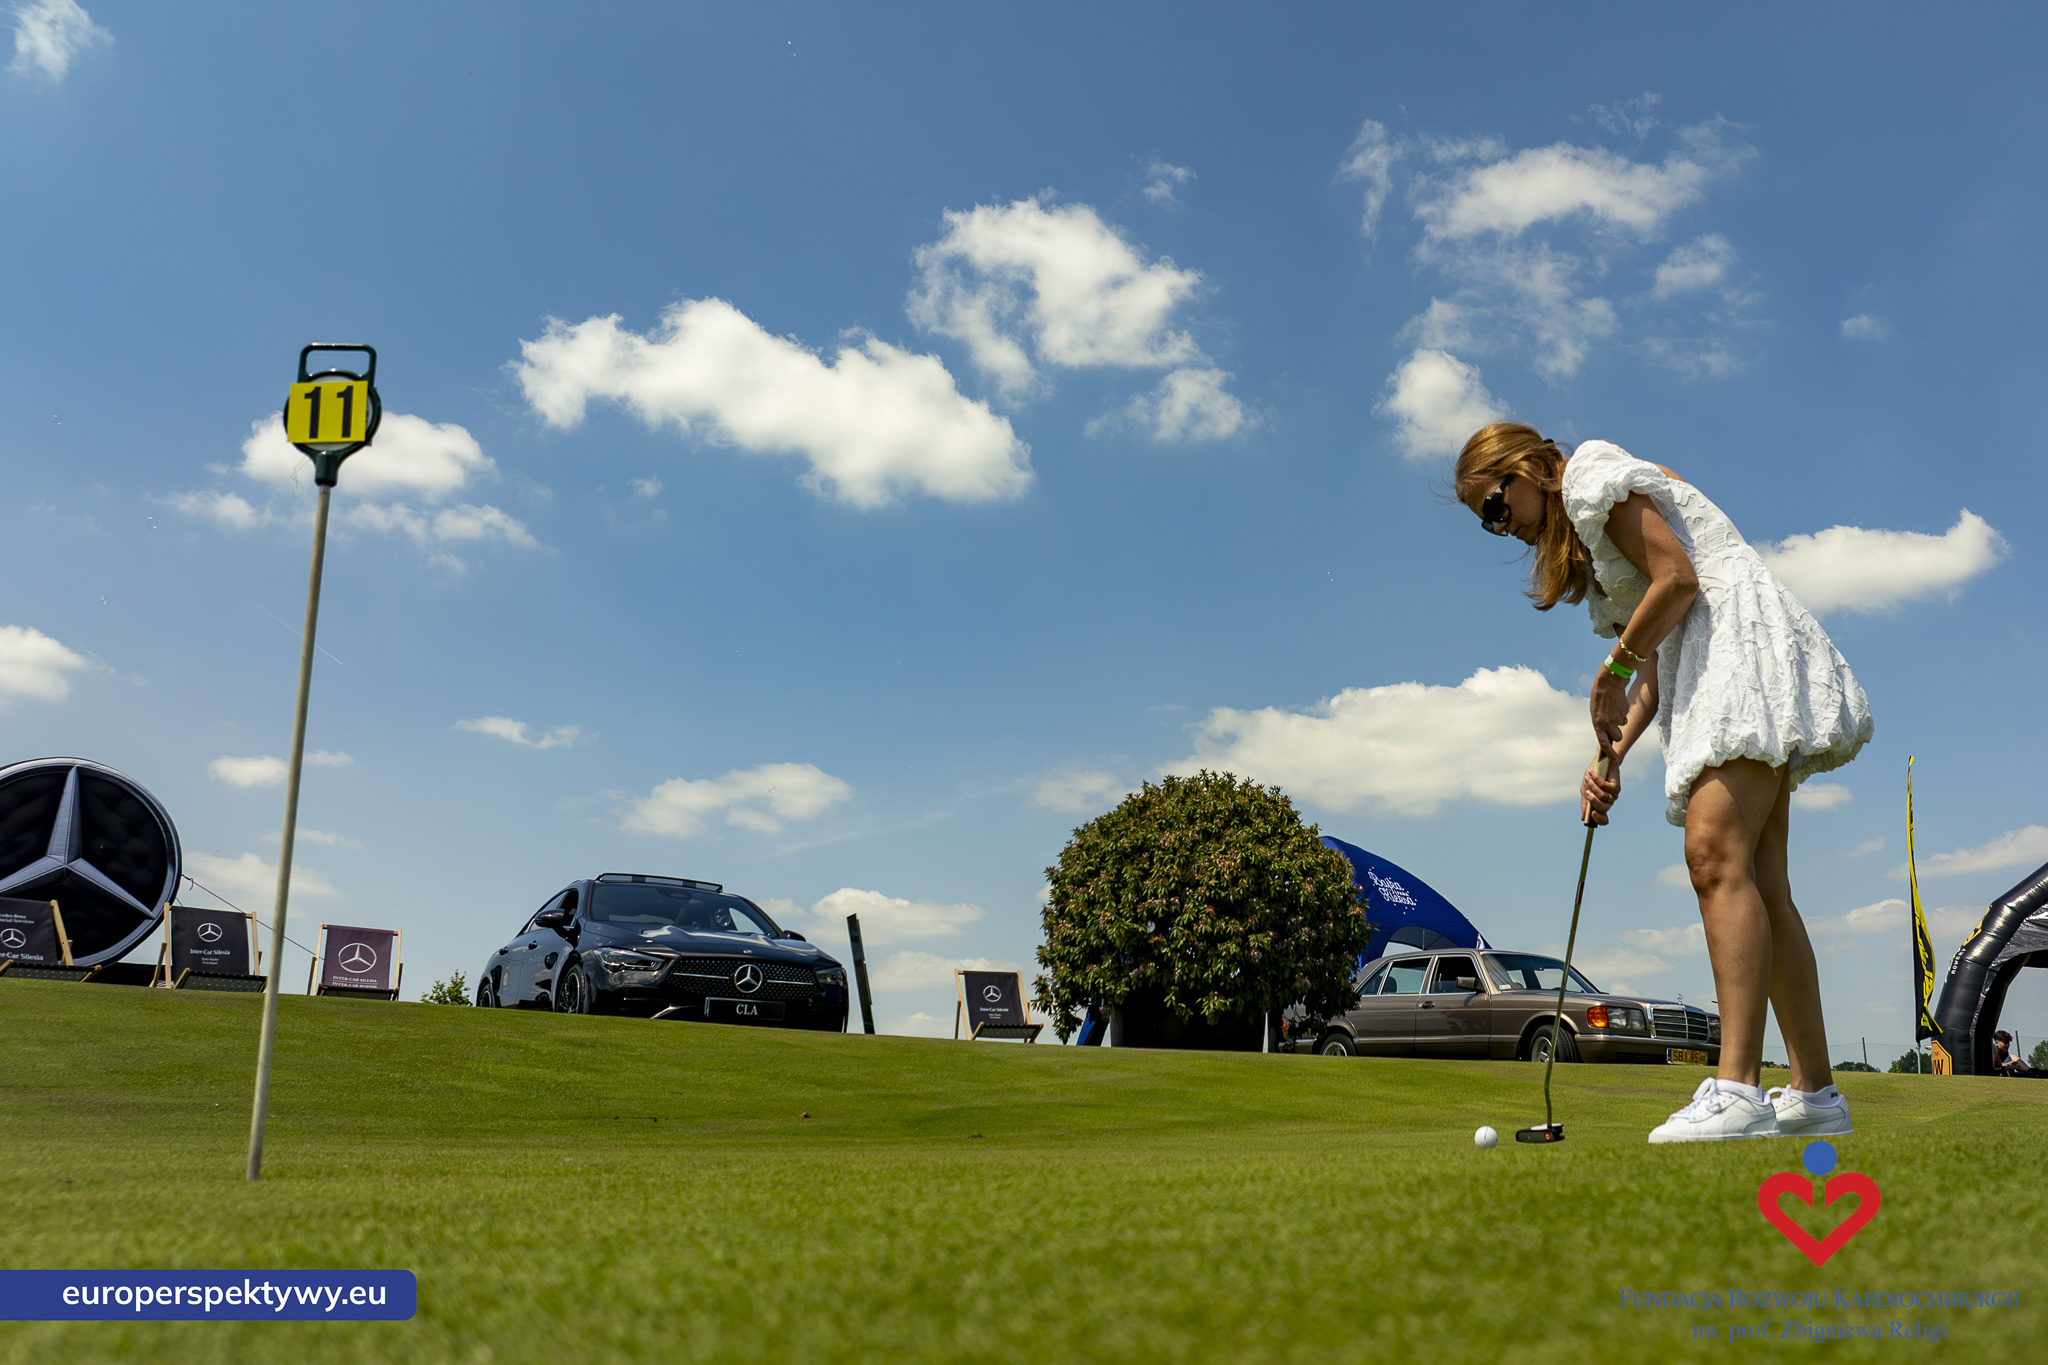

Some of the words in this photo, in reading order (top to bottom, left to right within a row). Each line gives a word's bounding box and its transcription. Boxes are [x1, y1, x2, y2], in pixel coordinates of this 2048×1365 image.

[304, 385, 354, 439] 11
[20, 953, 44, 961] Silesia
[736, 1003, 758, 1016] CLA
